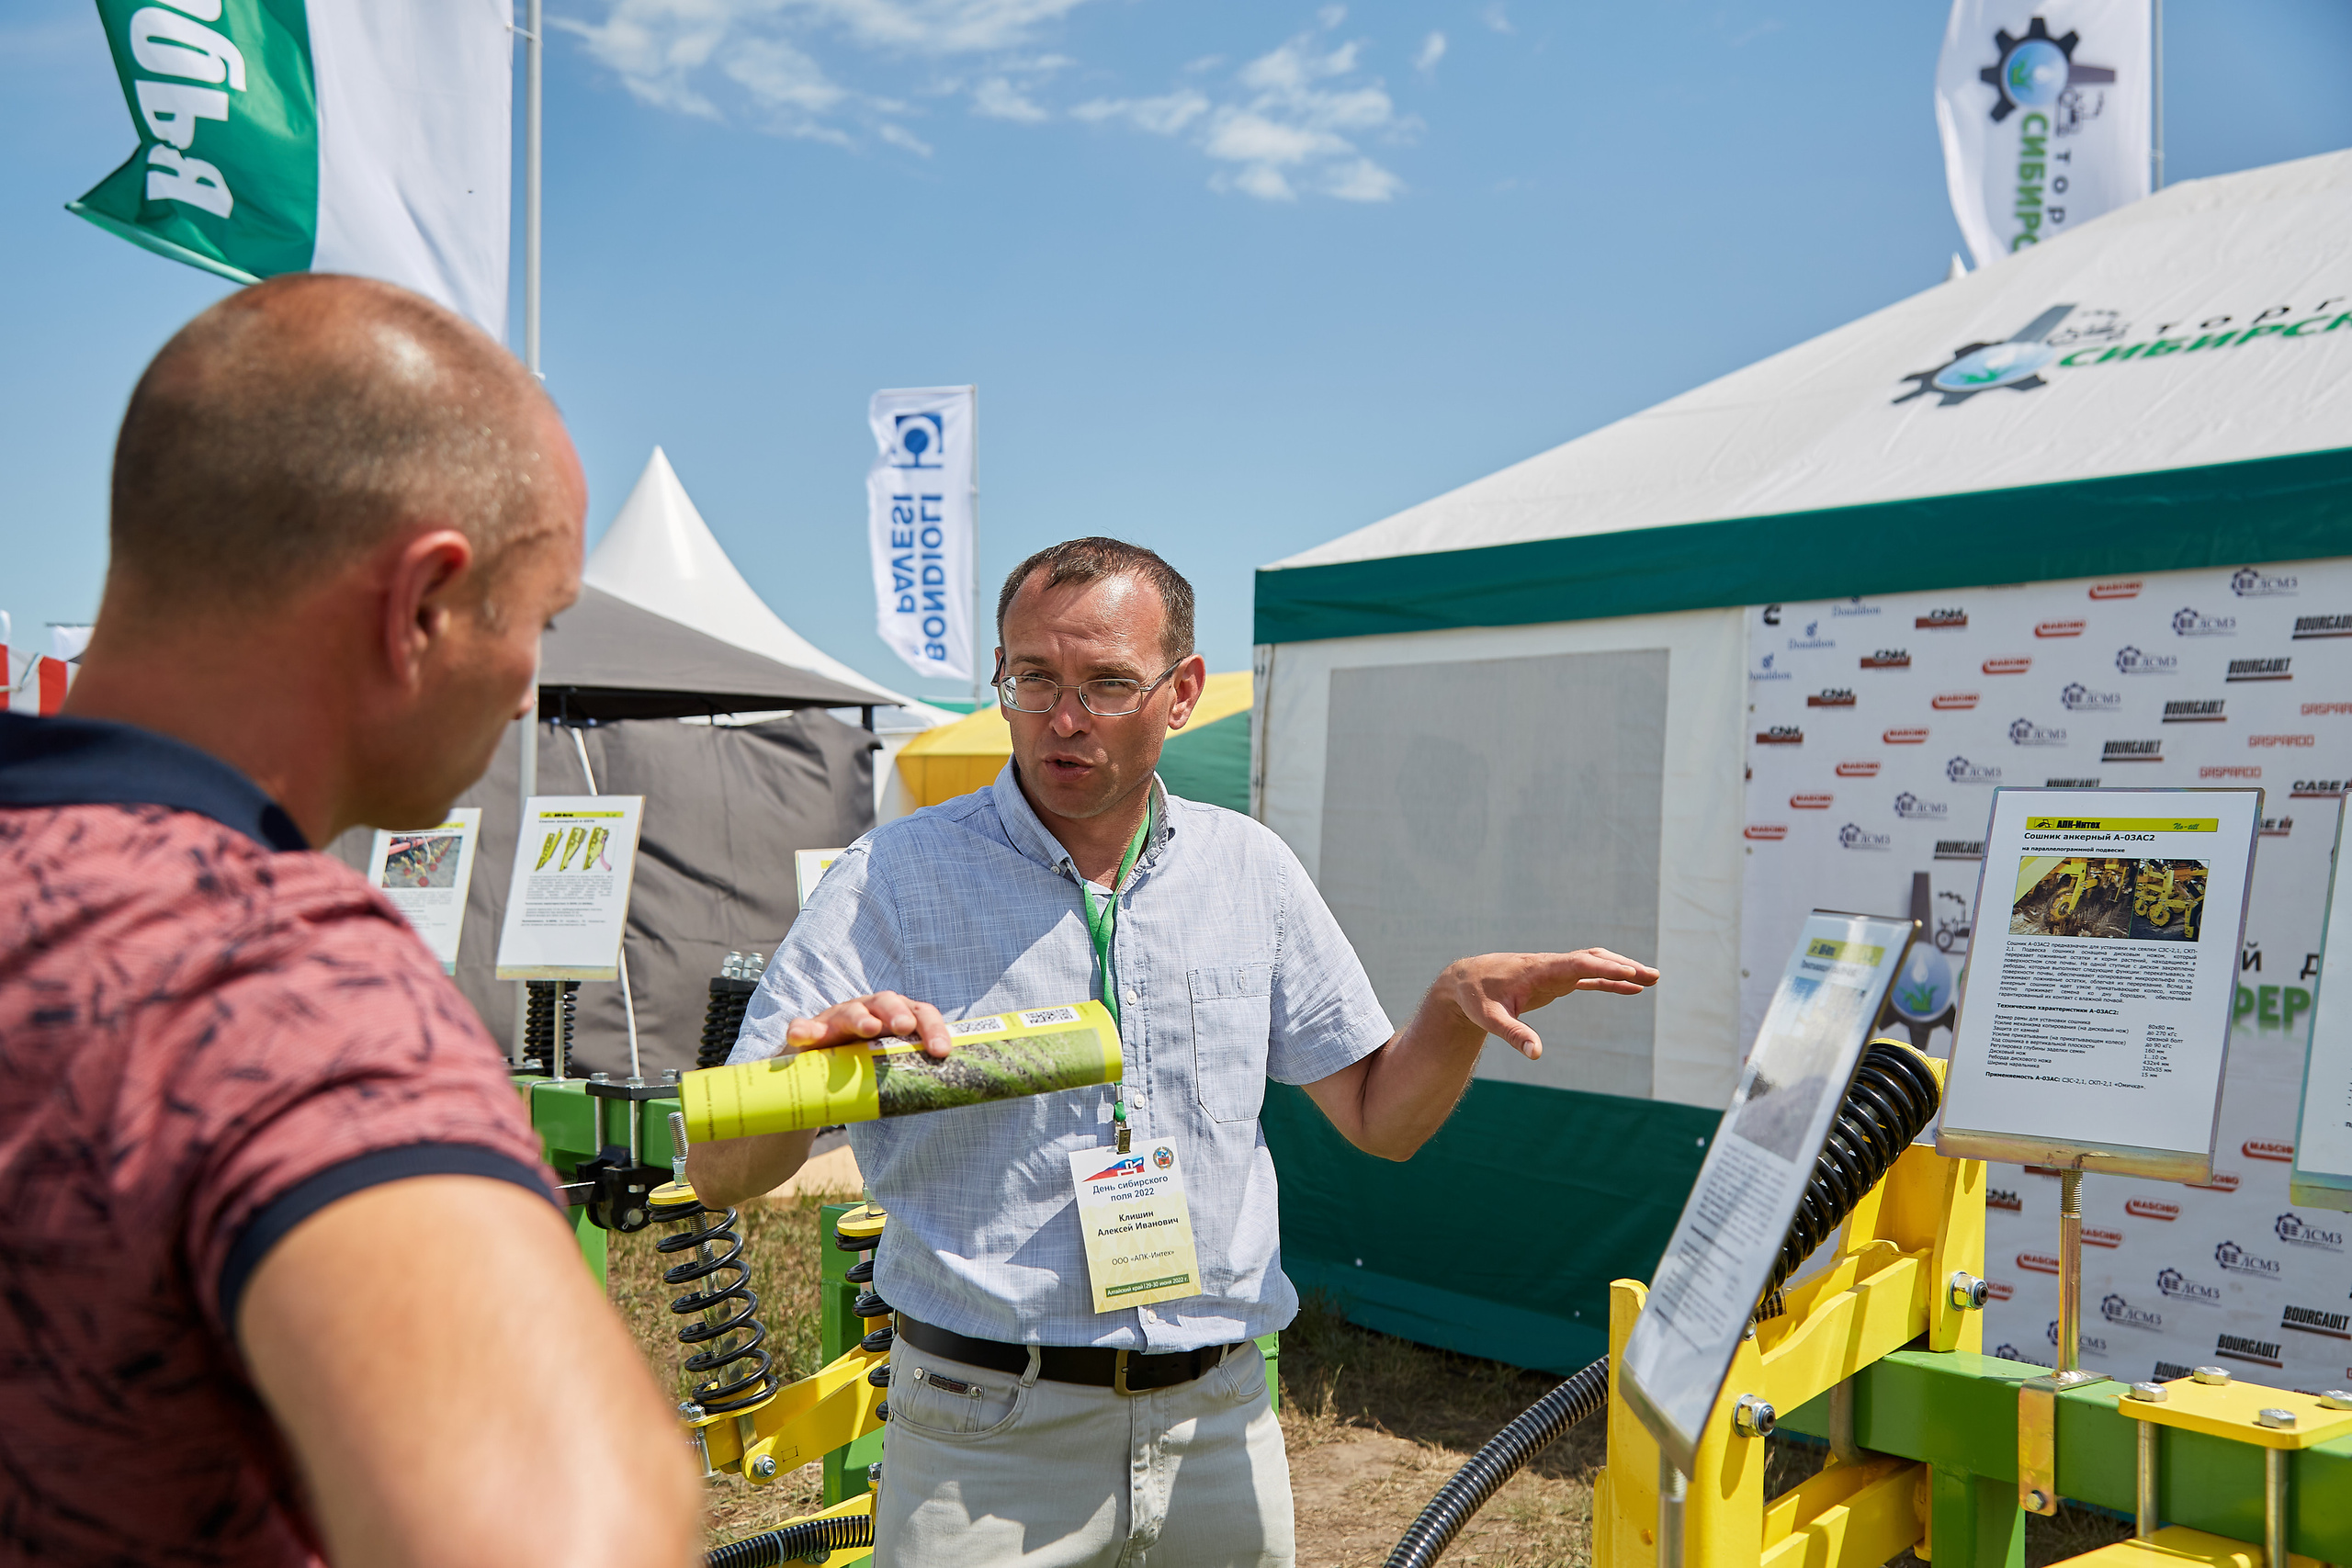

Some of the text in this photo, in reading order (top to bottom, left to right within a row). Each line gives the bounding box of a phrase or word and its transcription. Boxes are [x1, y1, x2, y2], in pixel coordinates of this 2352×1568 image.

[2063, 833, 2111, 841] анкерный
[1092, 1176, 1169, 1195] День сибирского
[1111, 1187, 1155, 1201] поля 2022
[2133, 1200, 2180, 1213] MASCHIO
[1118, 1211, 1154, 1222] Клишин
[1098, 1217, 1179, 1236] Алексей Иванович
[2301, 1228, 2342, 1245] ЛСМЗ
[1112, 1250, 1175, 1266] ООО «АПК-Интех»
[2240, 1257, 2279, 1272] ЛСМЗ
[1107, 1286, 1131, 1296] Алтайский
[1132, 1284, 1144, 1292] край
[2283, 1305, 2350, 1330] BOURGAULT
[2217, 1334, 2281, 1359] BOURGAULT
